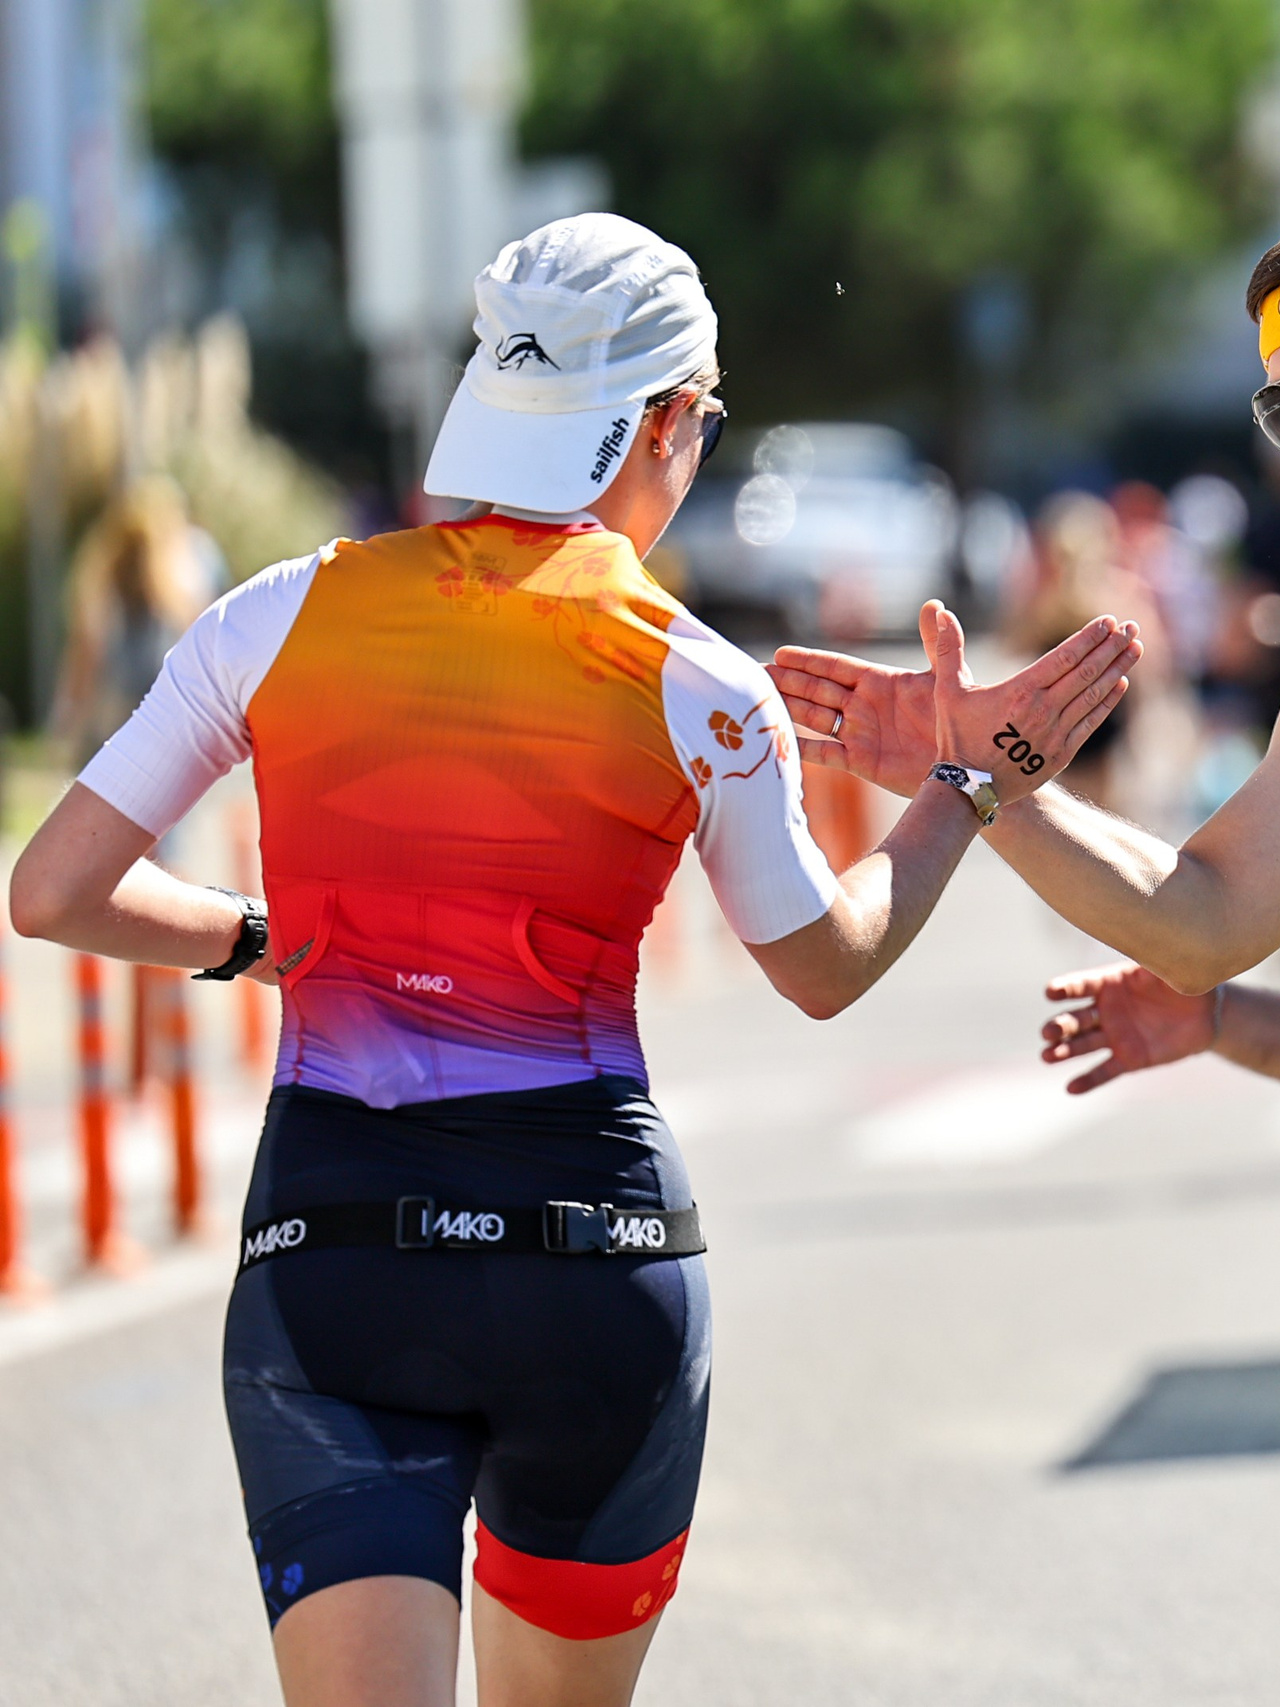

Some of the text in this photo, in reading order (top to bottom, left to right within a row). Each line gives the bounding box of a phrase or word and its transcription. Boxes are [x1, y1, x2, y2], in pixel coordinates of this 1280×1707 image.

[590, 417, 630, 484] sailfish
[992, 722, 1045, 776] 602
[396, 972, 454, 995] MAKO
[243, 1218, 307, 1265] MAKO
[421, 1208, 505, 1242] MAKO
